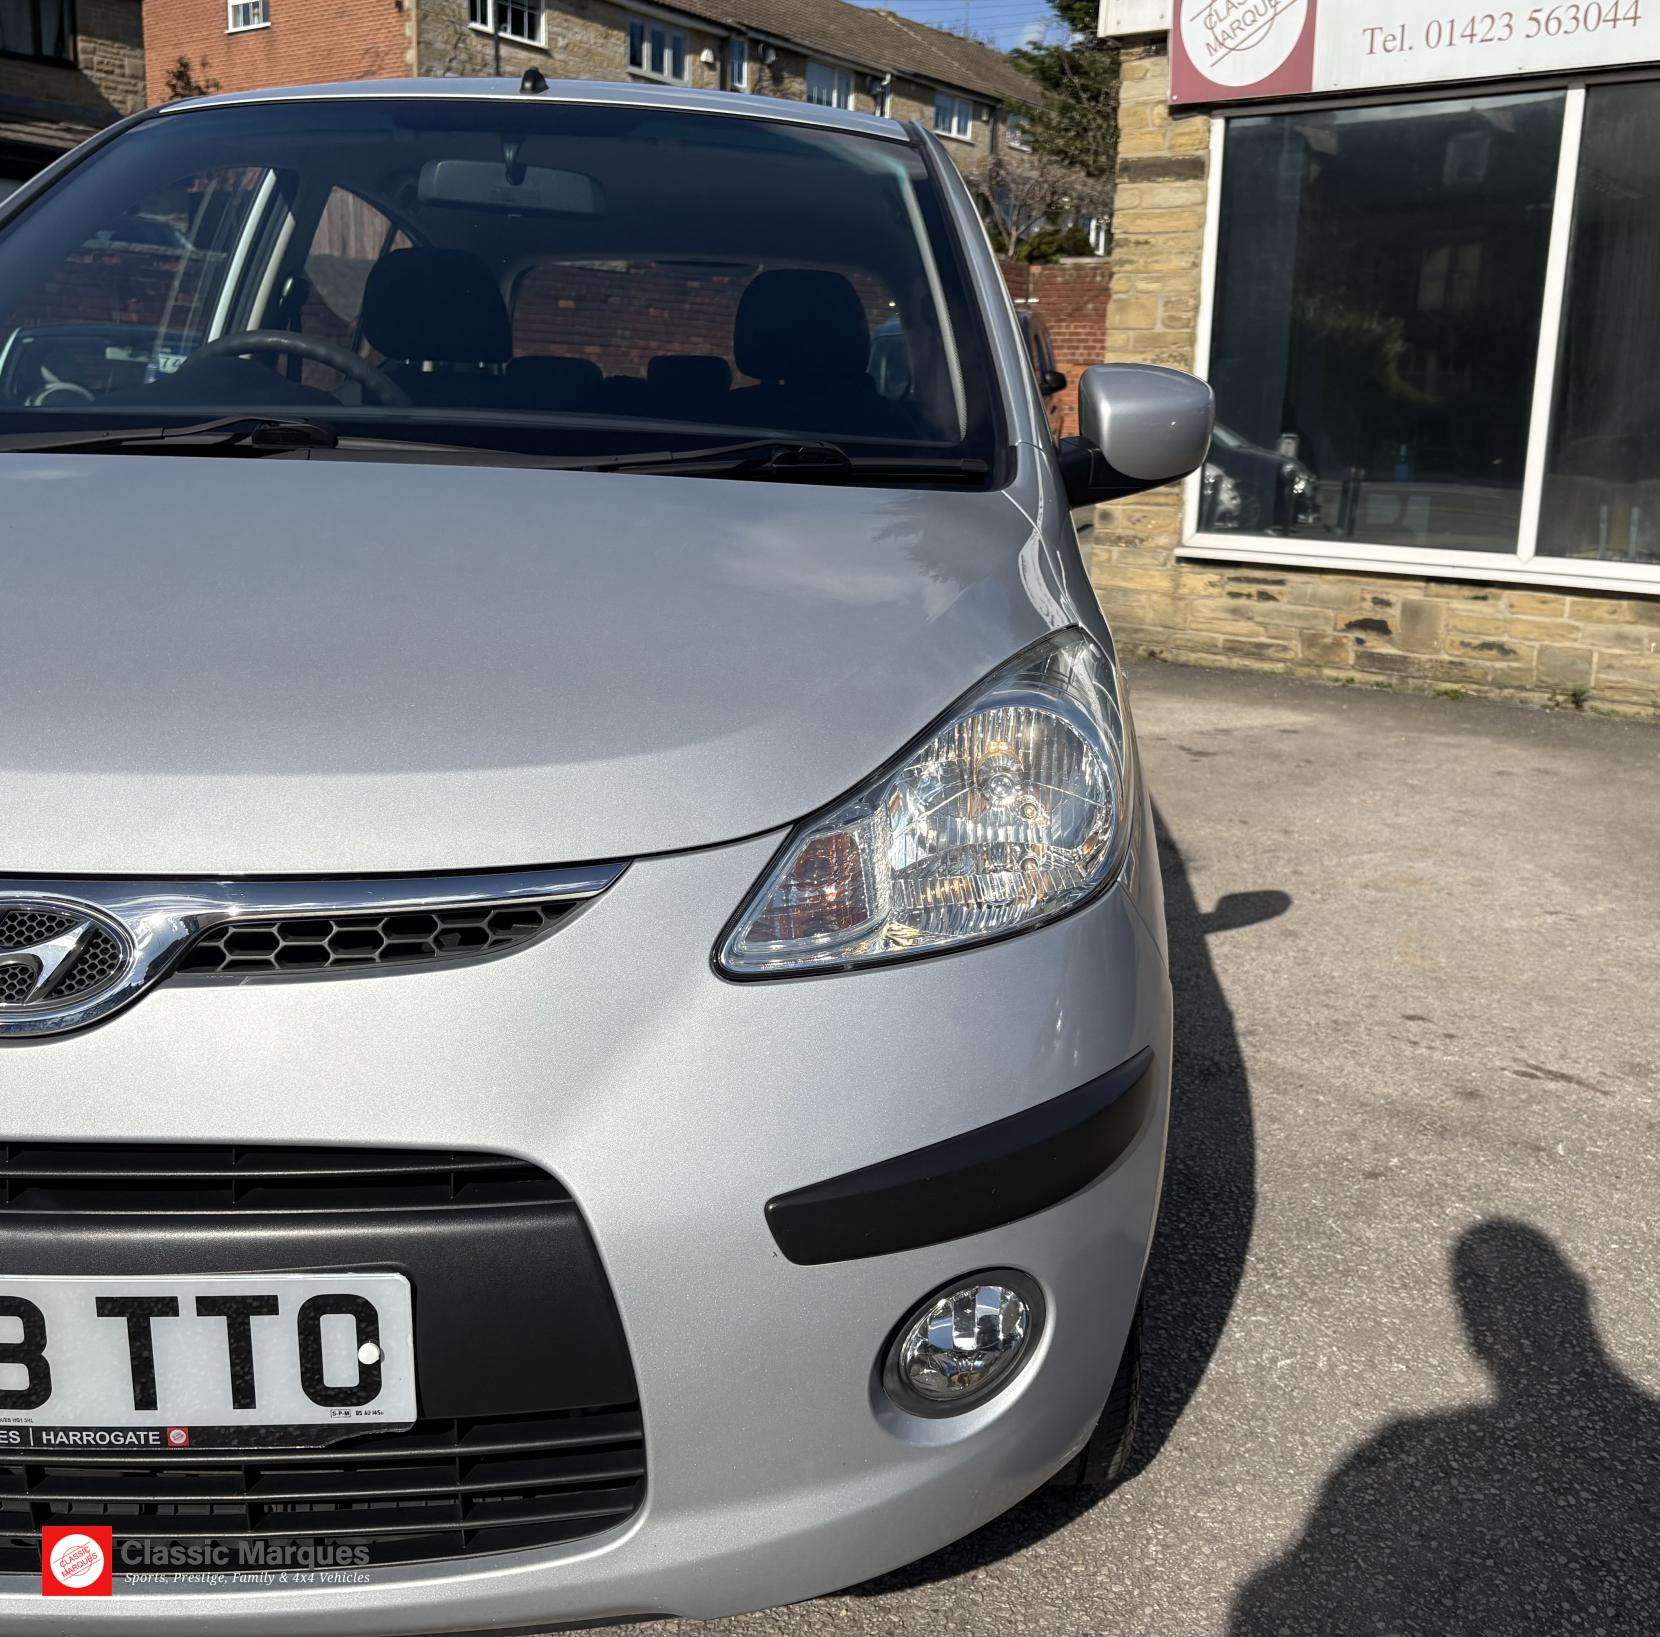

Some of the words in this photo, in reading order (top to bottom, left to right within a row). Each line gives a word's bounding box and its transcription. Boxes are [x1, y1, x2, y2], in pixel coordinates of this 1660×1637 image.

[1362, 23, 1413, 55] Tel.
[1424, 11, 1515, 49] 01423
[1525, 0, 1642, 39] 563044
[95, 1293, 382, 1408] TTO
[42, 1431, 161, 1445] HARROGATE
